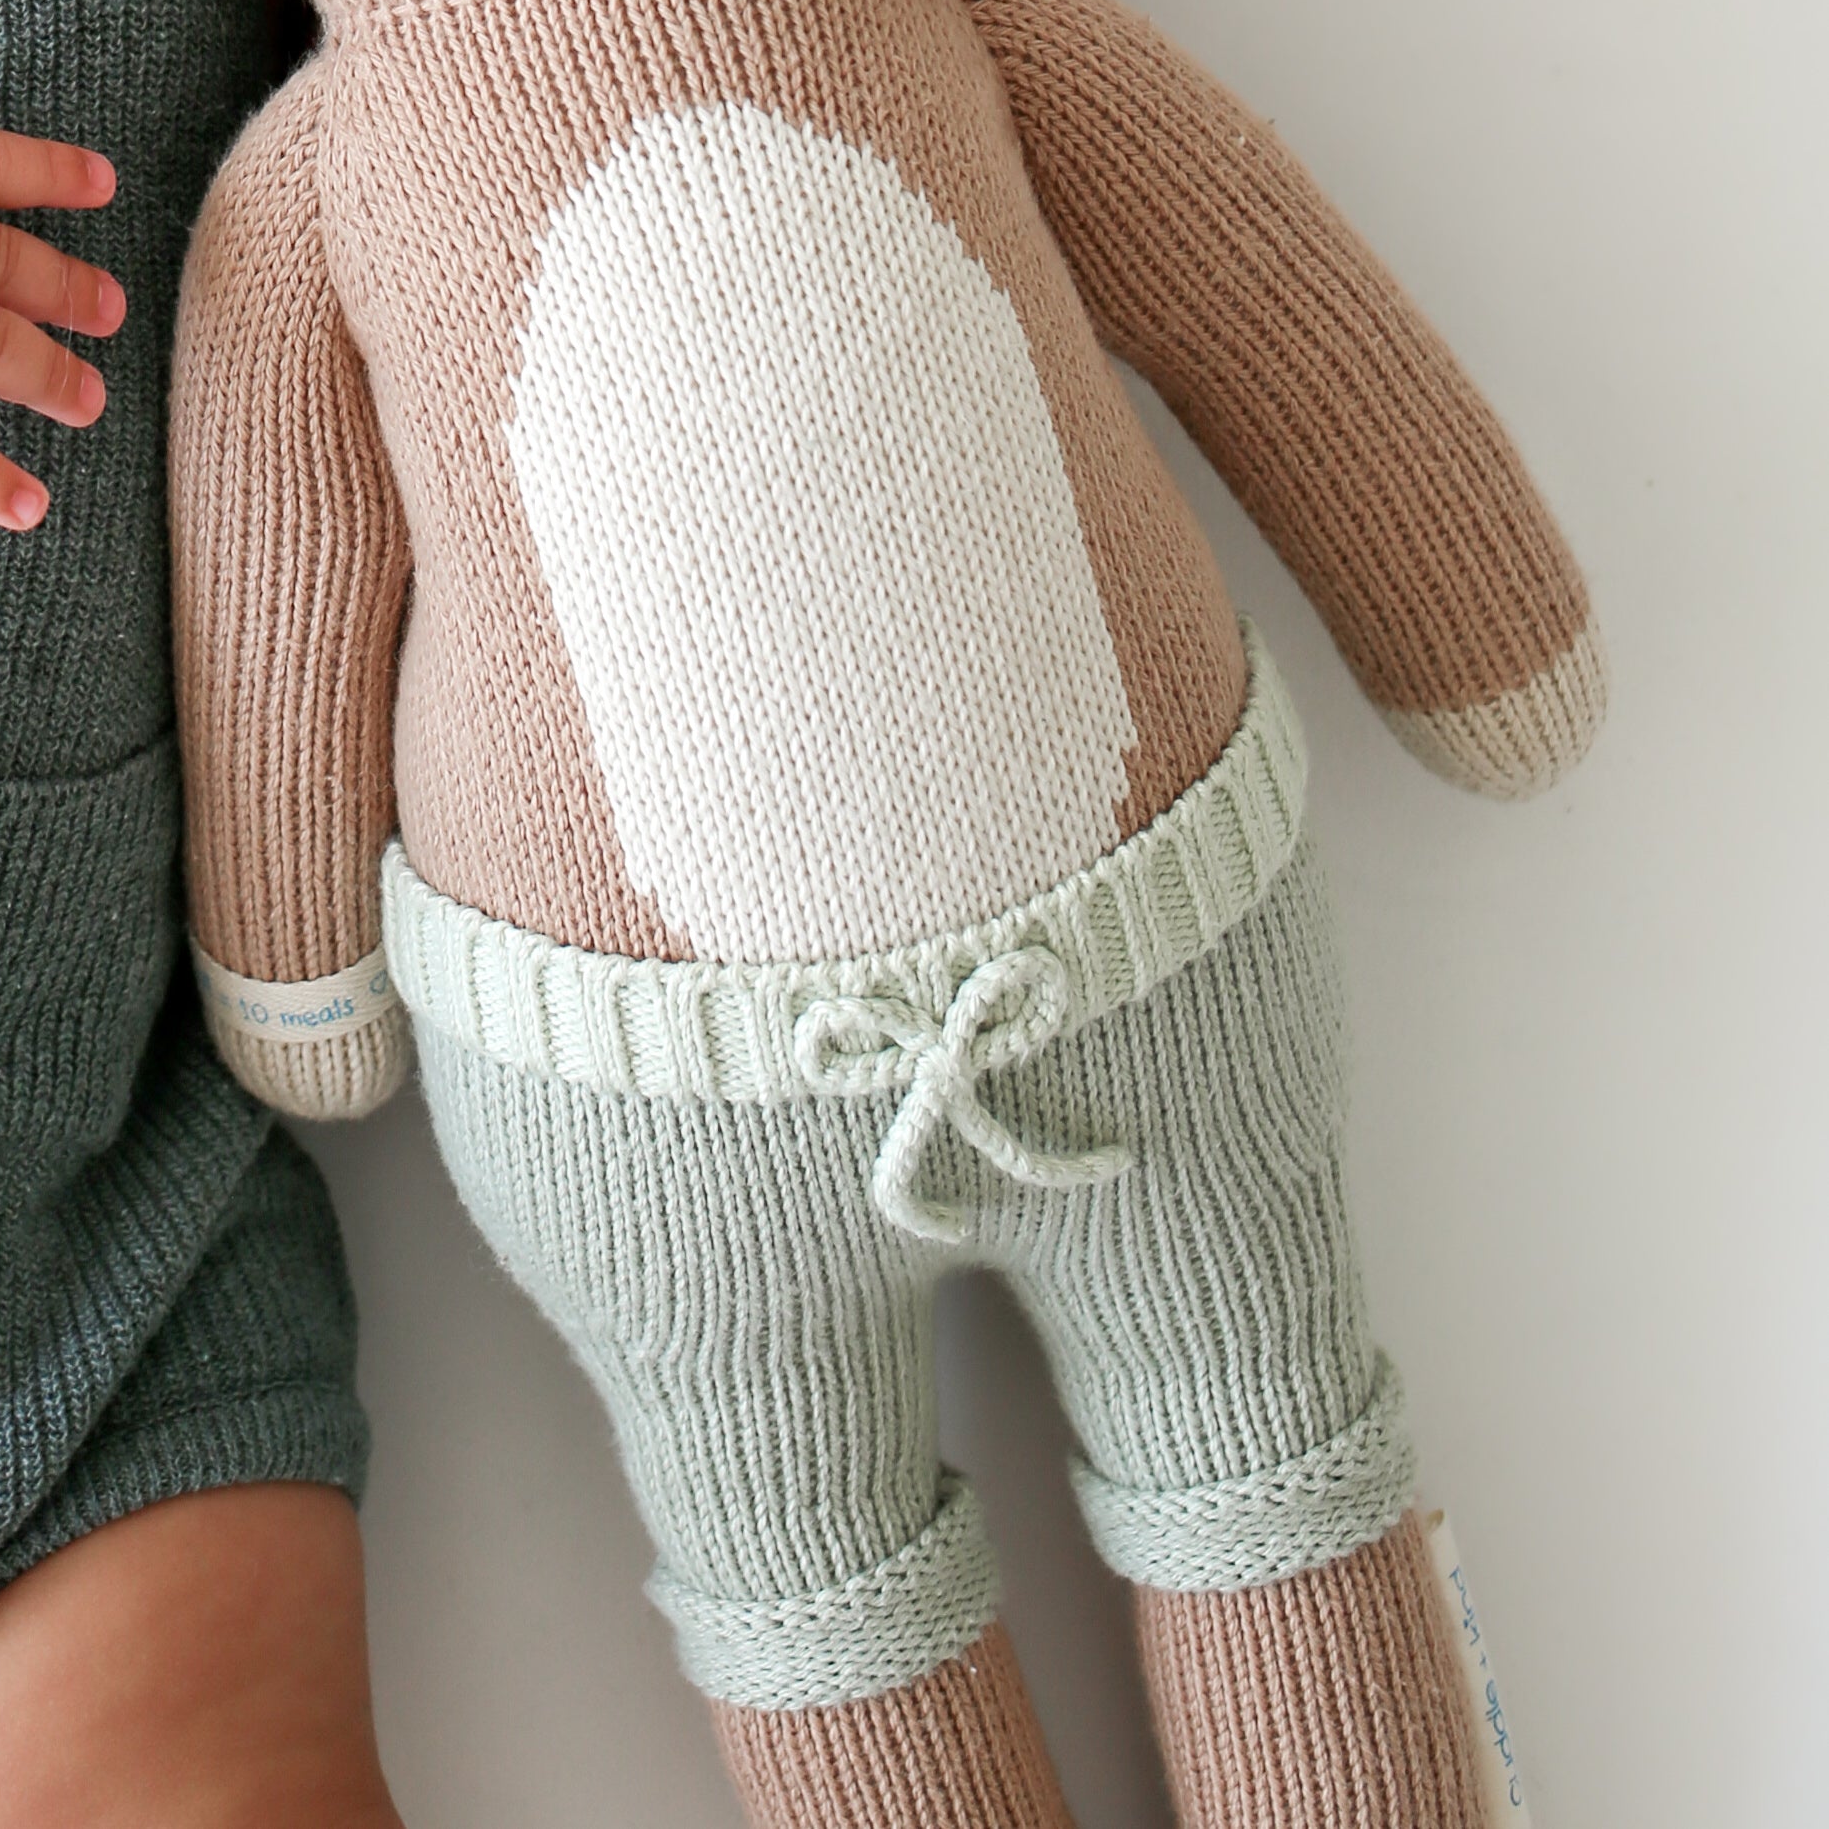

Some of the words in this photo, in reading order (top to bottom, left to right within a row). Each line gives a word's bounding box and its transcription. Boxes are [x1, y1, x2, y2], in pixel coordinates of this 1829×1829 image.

[238, 998, 269, 1024] 10
[280, 998, 355, 1027] meals
[1449, 1565, 1480, 1647] kind
